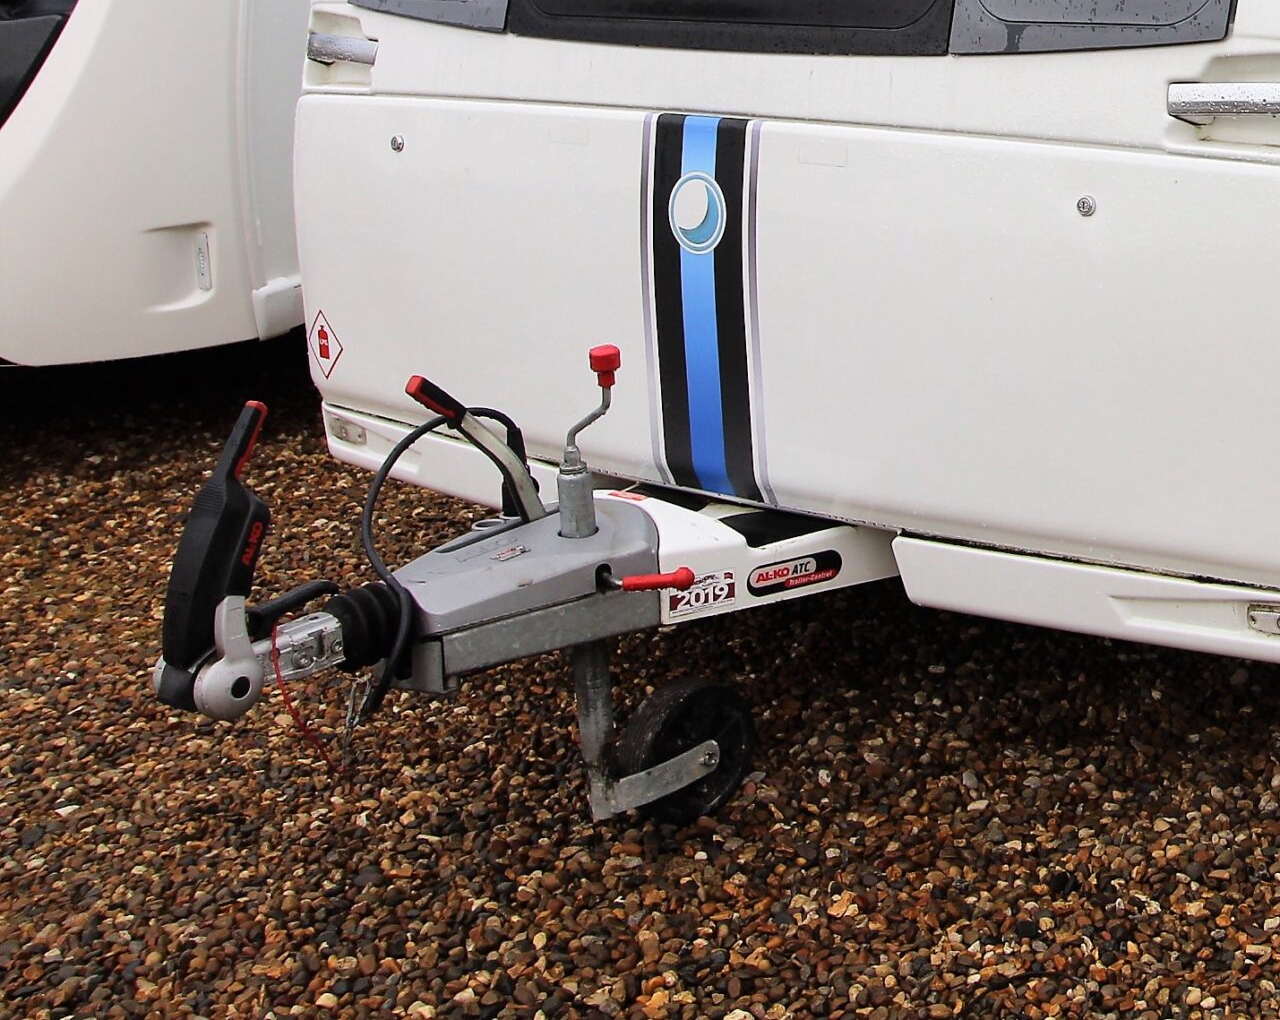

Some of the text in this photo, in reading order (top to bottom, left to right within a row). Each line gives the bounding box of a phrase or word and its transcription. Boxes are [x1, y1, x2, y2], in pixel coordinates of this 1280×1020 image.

[756, 561, 811, 583] AL-KO ATC
[677, 585, 729, 611] 2019
